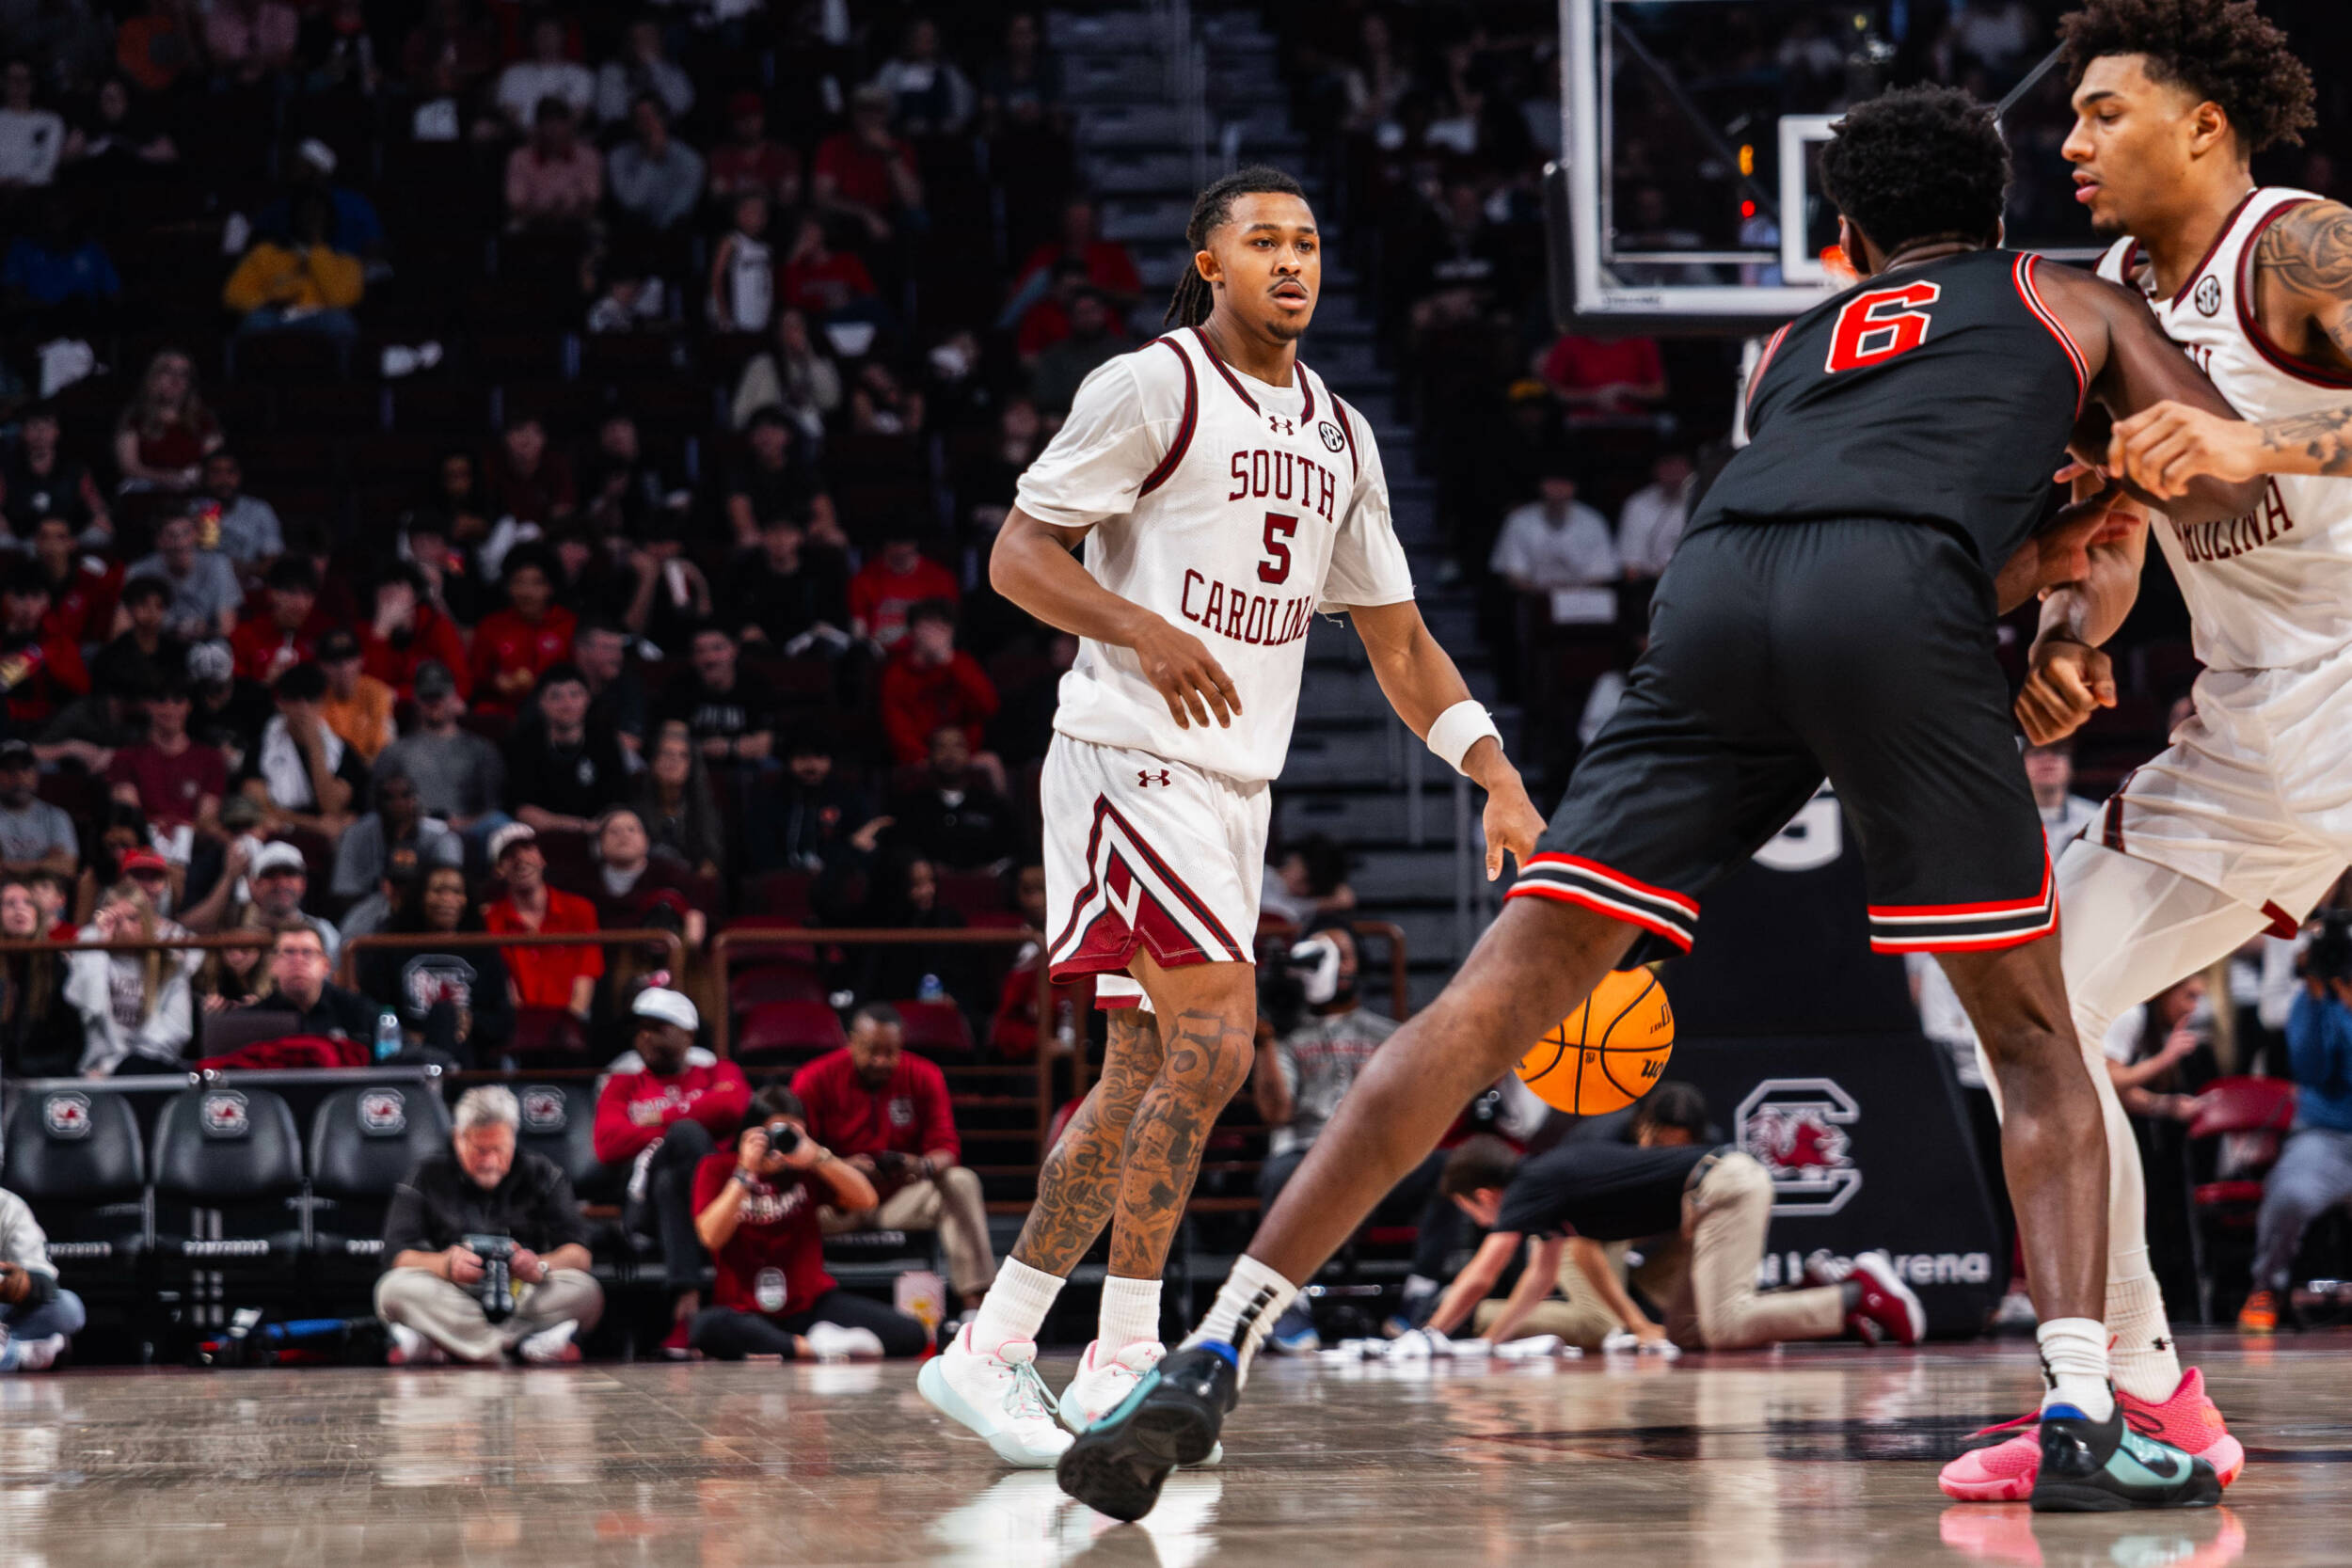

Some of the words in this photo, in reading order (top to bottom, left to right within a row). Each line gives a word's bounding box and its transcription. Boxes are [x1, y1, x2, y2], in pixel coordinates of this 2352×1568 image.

[1825, 280, 1942, 373] 6
[1229, 450, 1335, 523] SOUTH
[1257, 512, 1299, 585] 5
[1880, 1249, 1992, 1285] rena
